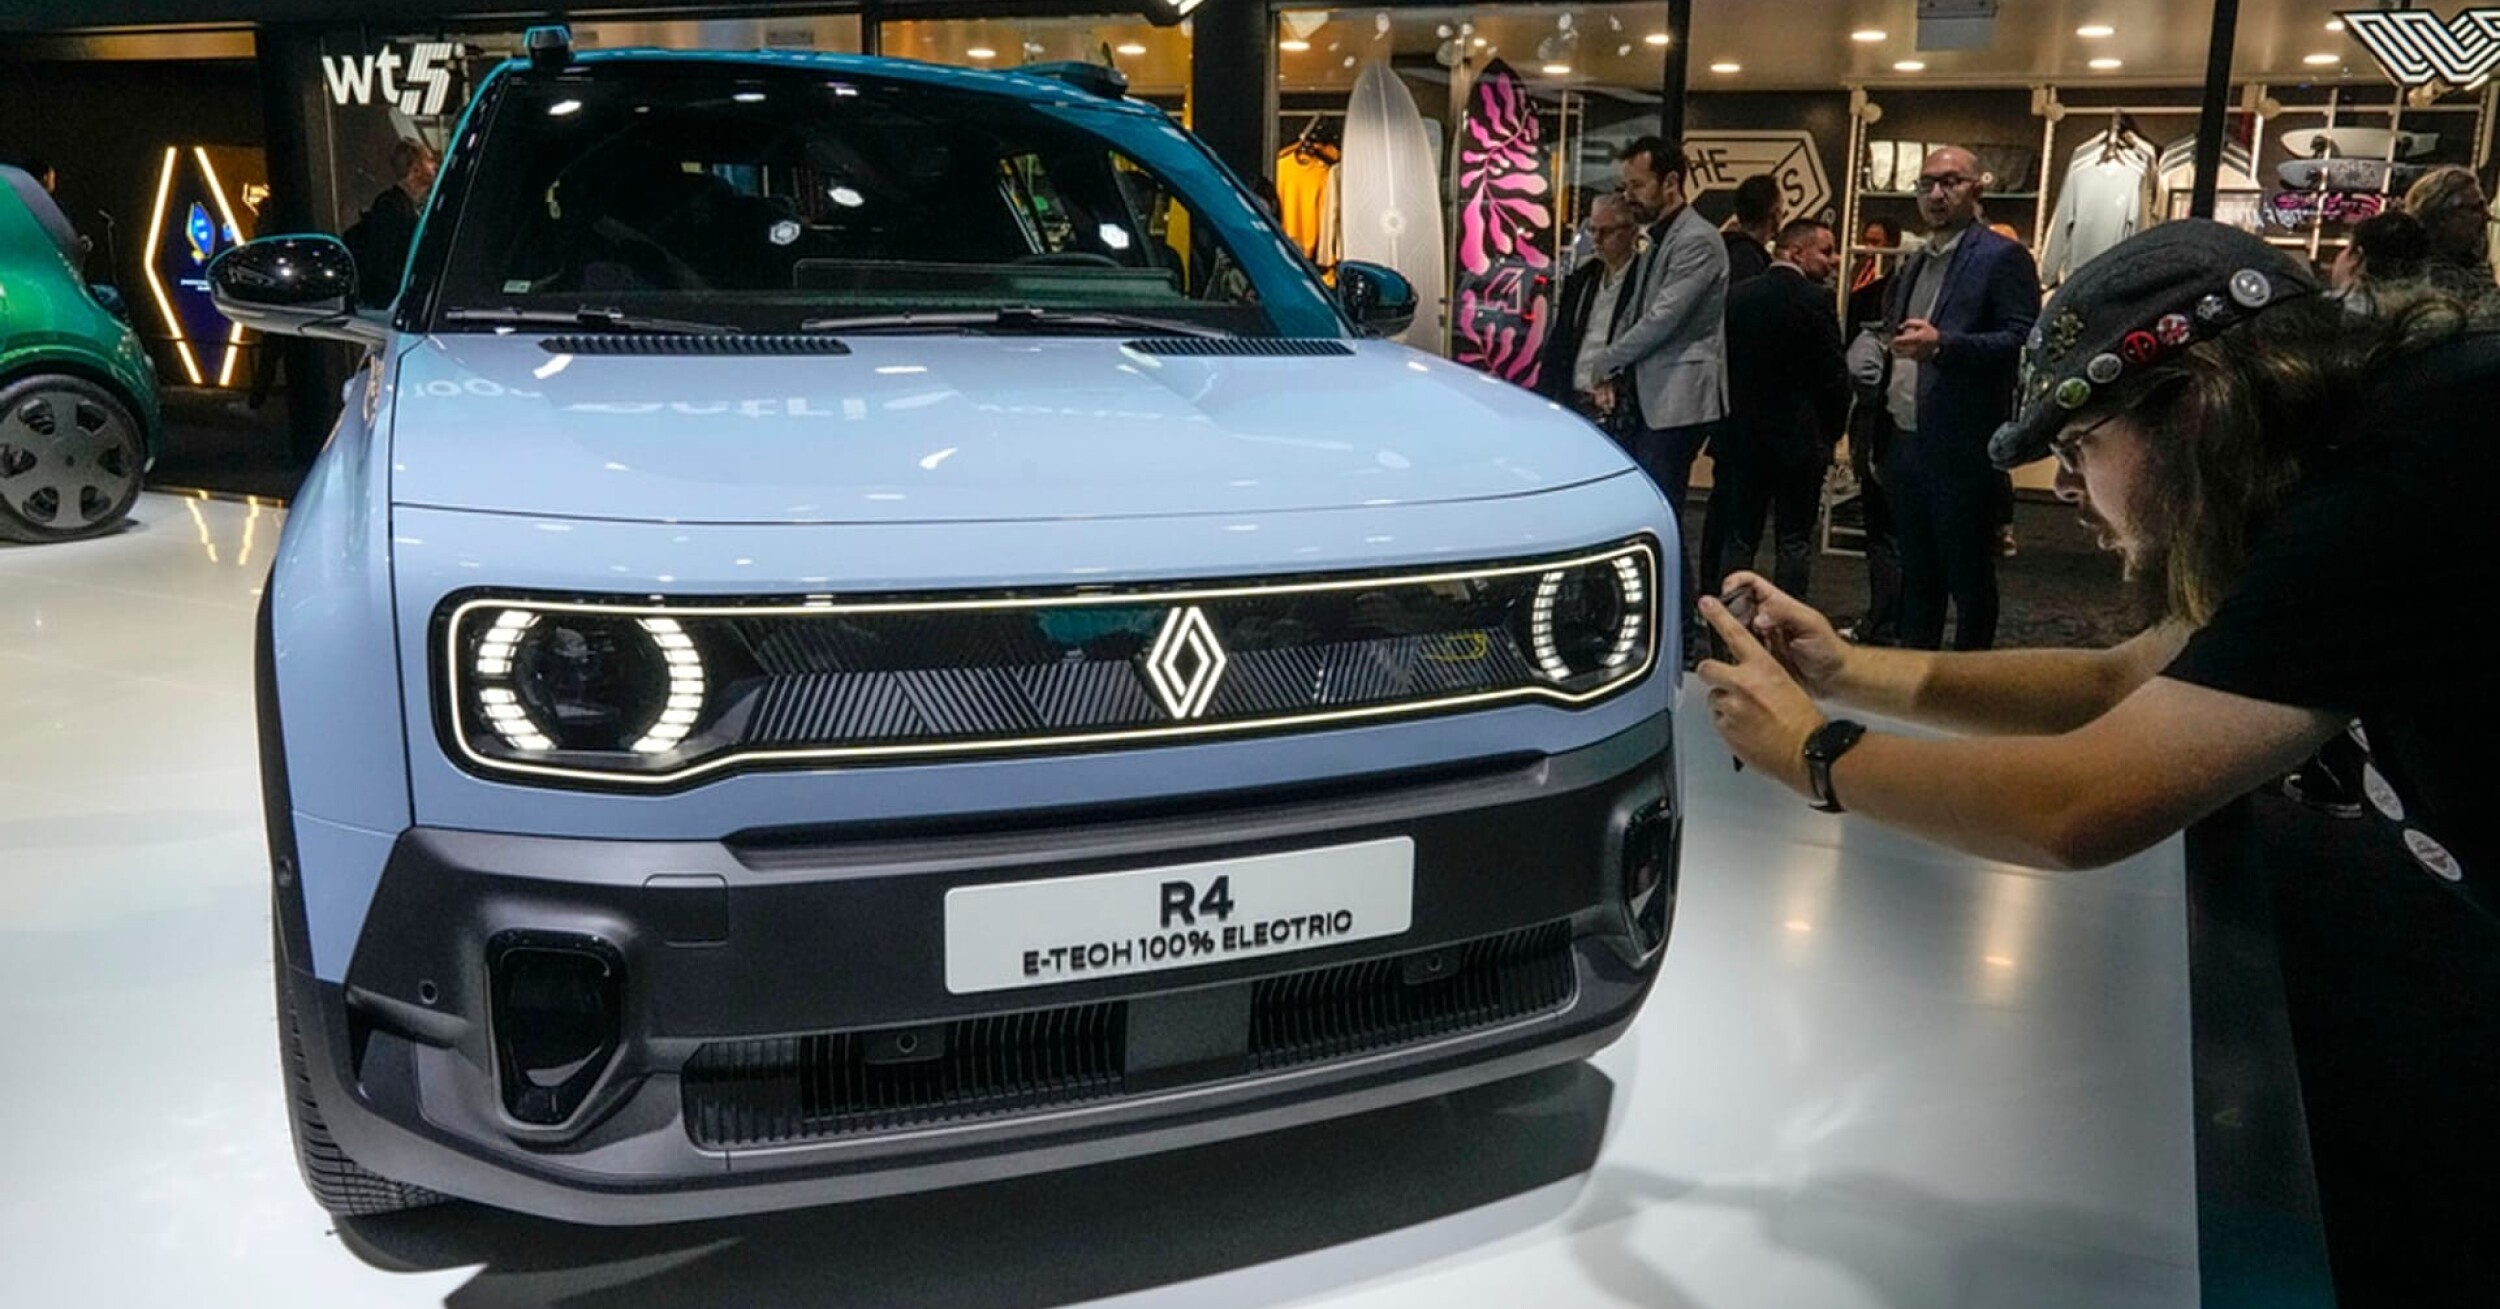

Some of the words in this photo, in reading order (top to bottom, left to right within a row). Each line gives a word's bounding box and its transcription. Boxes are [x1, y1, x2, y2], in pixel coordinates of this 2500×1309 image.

[1687, 148, 1737, 189] HE
[1160, 874, 1234, 929] R4
[1138, 929, 1215, 963] 100%
